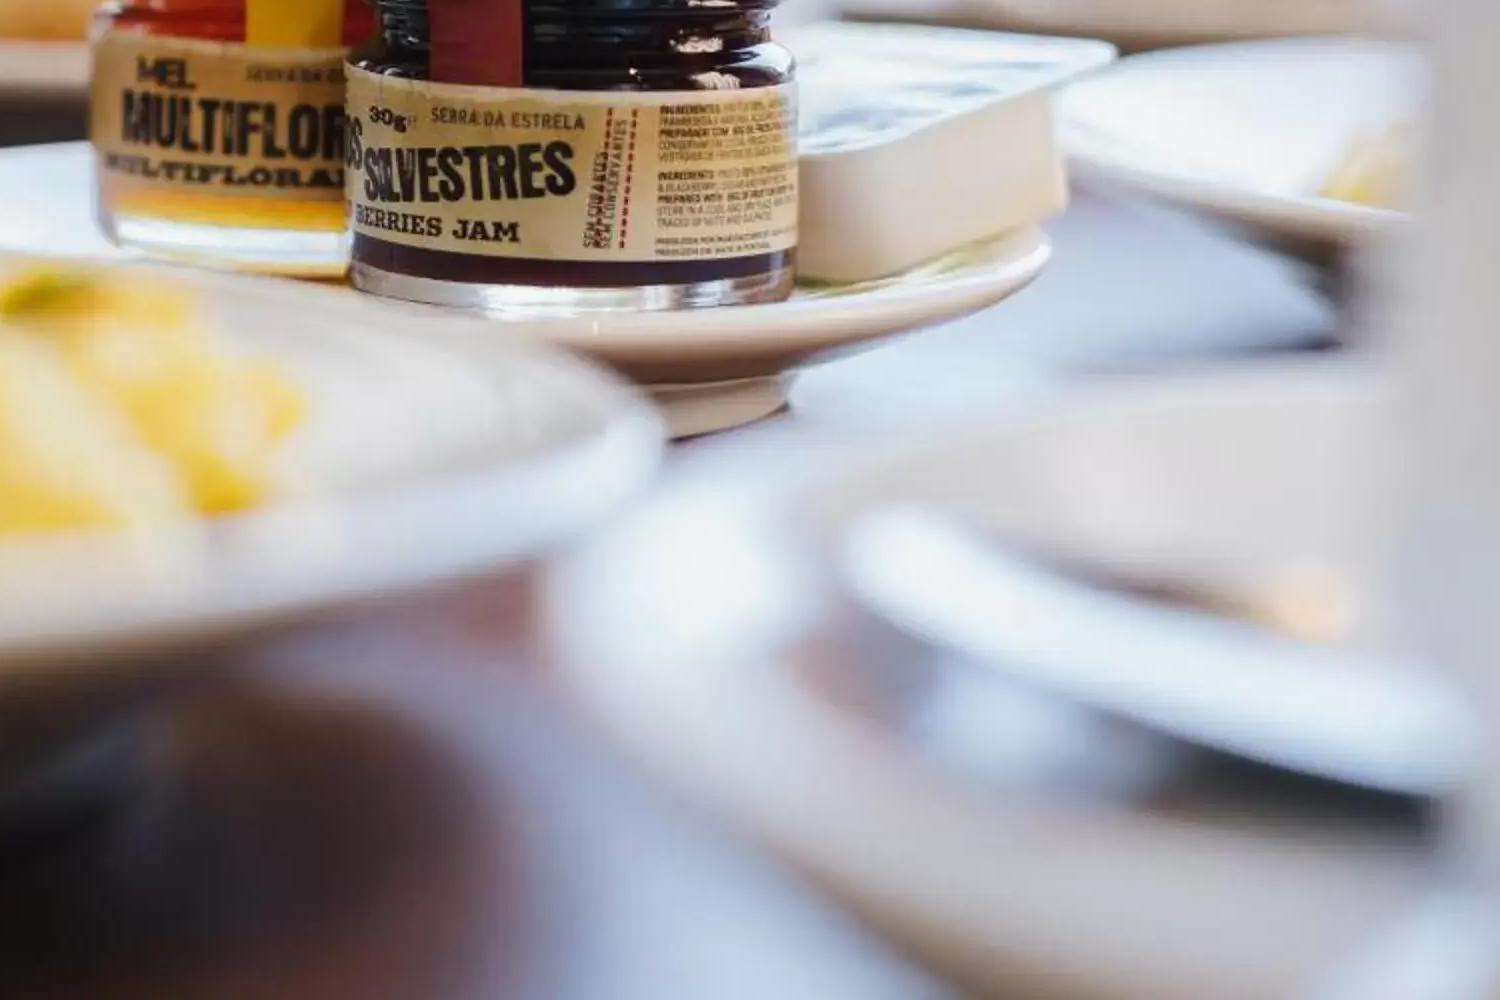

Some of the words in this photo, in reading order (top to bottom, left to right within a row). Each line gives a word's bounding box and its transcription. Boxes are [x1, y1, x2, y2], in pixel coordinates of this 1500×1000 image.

[138, 56, 196, 88] MEL
[124, 90, 346, 160] MULTIFLOR
[431, 107, 476, 126] SERRA
[483, 112, 506, 127] DA
[511, 112, 585, 130] ESTRELA
[108, 154, 344, 188] MULTIFLORA
[364, 140, 576, 203] SILVESTRES
[452, 219, 521, 243] JAM
